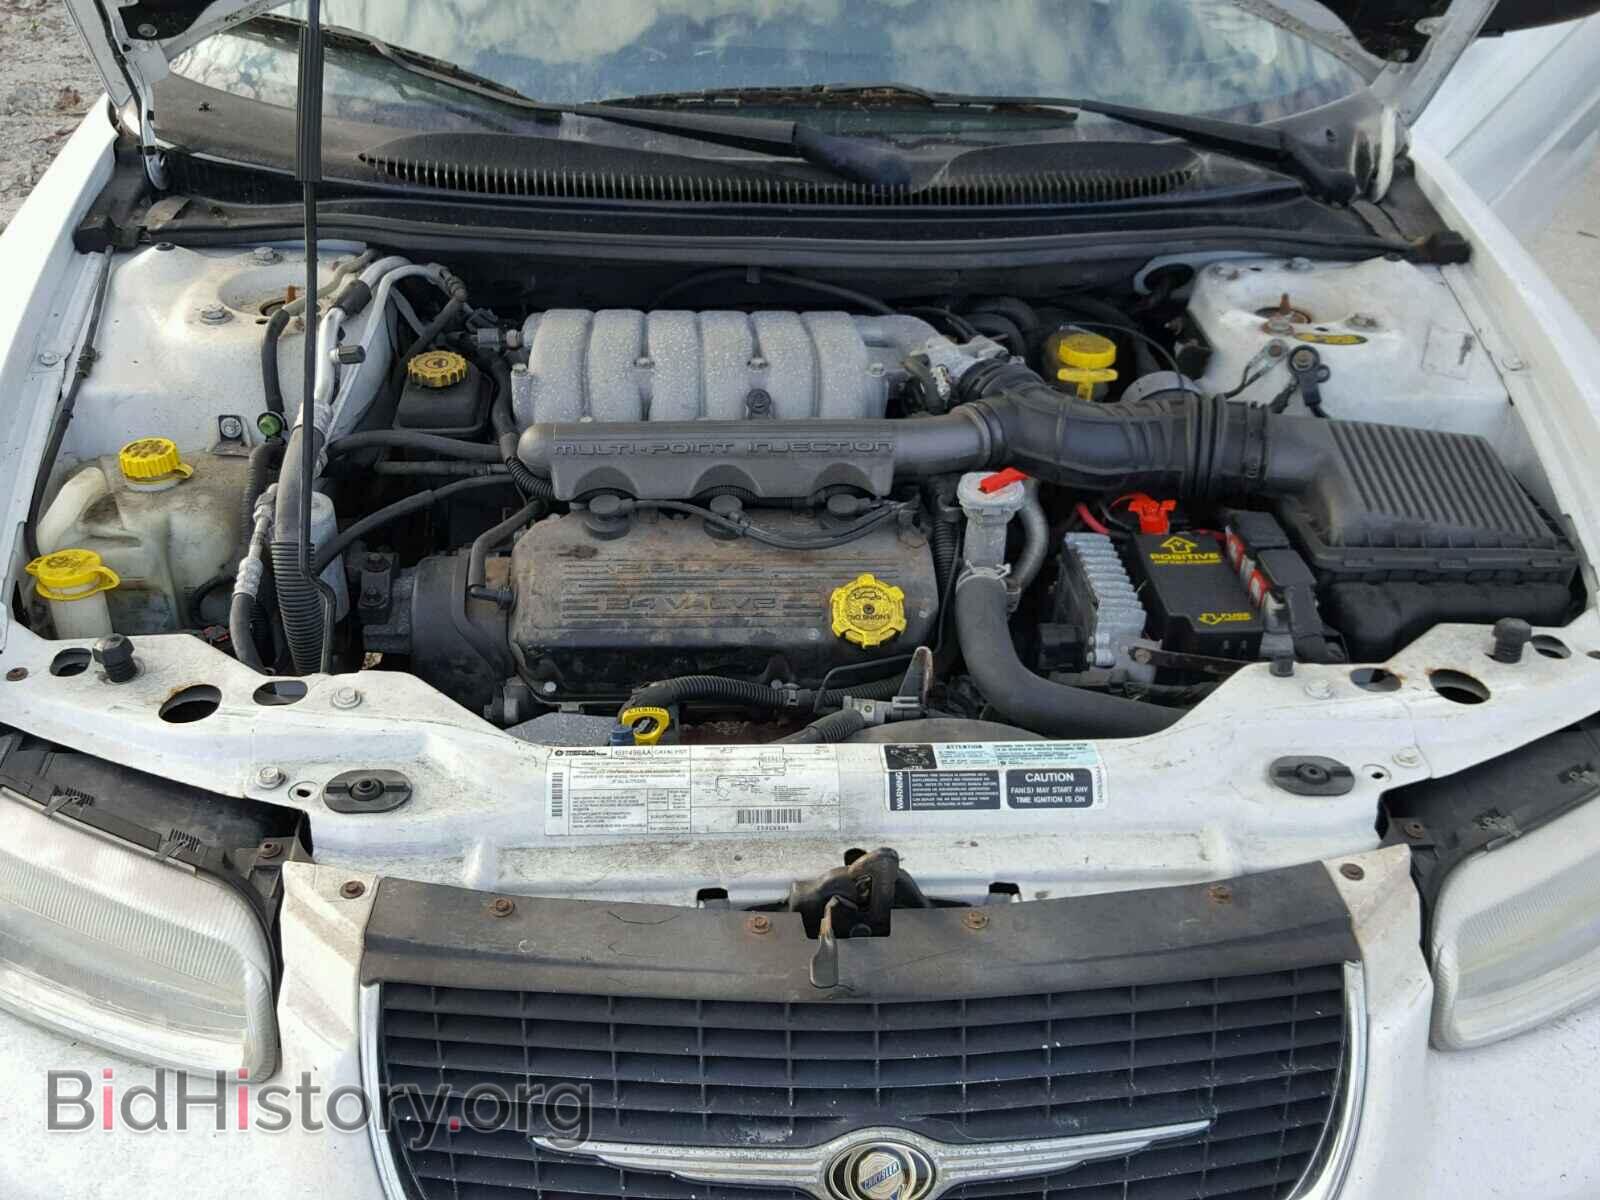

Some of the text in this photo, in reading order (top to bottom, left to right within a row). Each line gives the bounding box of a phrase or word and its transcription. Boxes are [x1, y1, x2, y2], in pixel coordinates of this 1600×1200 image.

[746, 439, 894, 454] INJECTION
[1150, 552, 1220, 560] POSITIVE
[660, 596, 778, 611] VALVE
[1025, 772, 1075, 783] CAUTION
[895, 771, 904, 810] WARNING
[1010, 785, 1089, 795] FAN(S) MAY START ANY
[1015, 795, 1086, 804] TIME IGNITION IS ON
